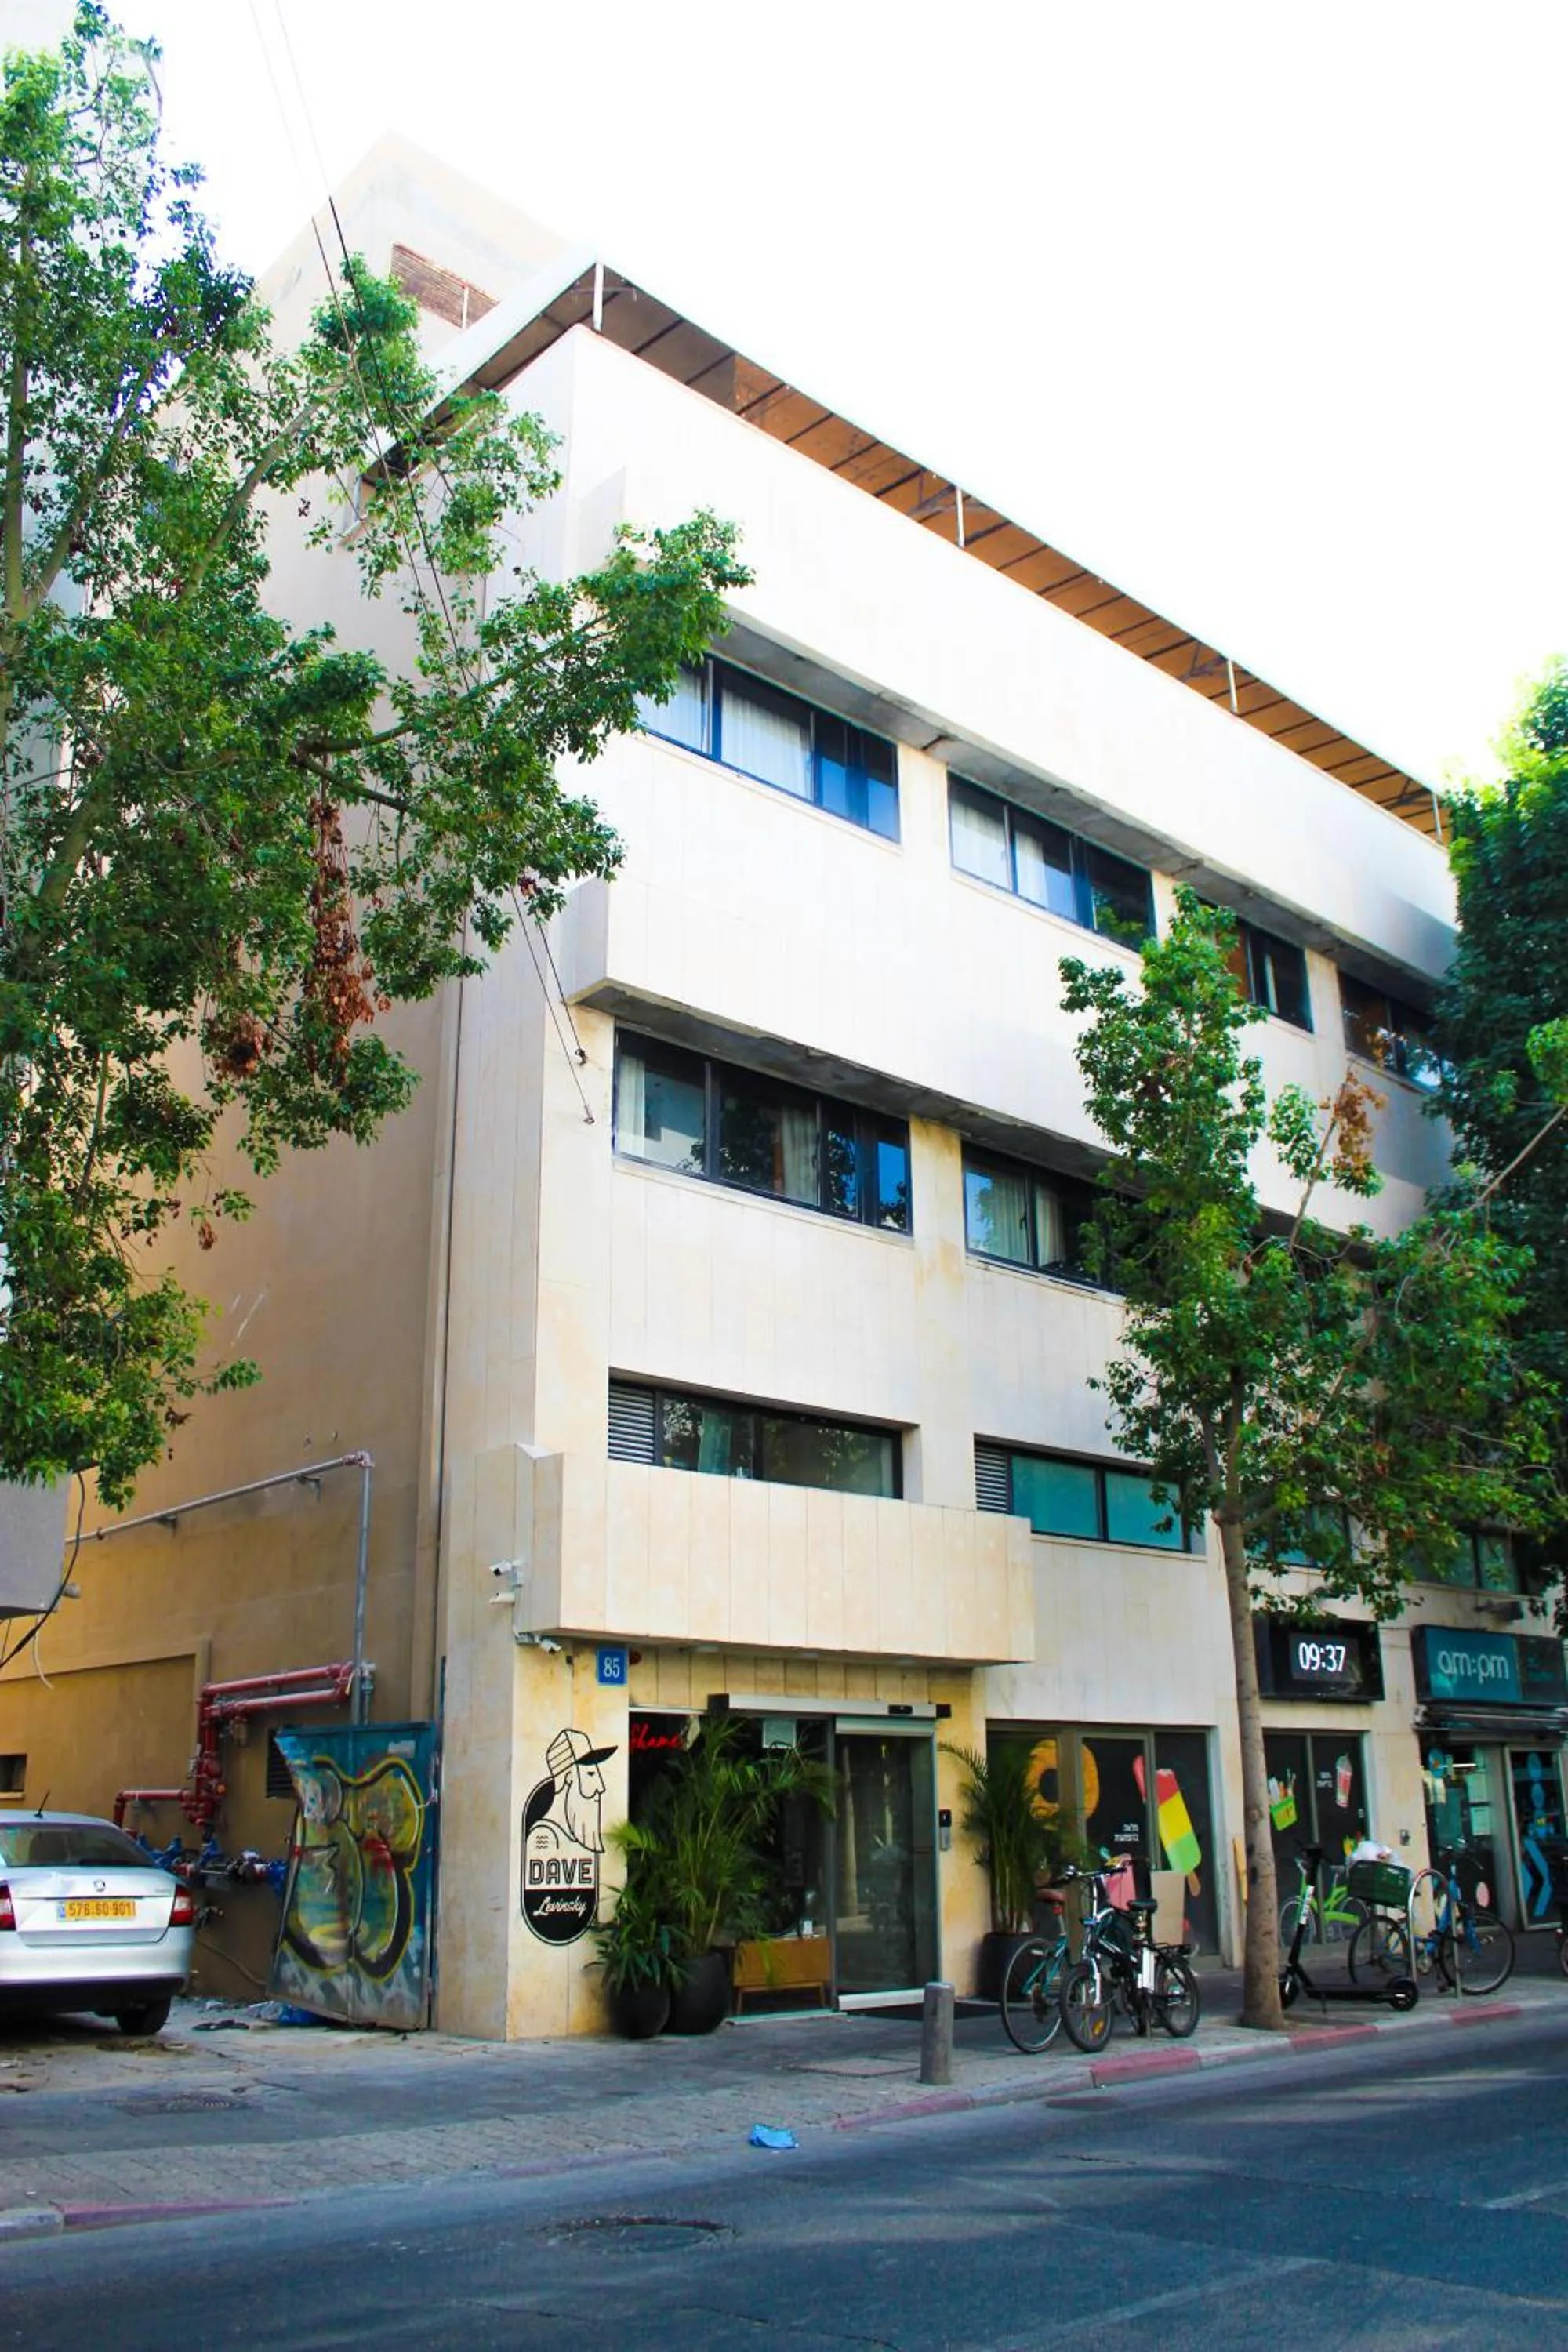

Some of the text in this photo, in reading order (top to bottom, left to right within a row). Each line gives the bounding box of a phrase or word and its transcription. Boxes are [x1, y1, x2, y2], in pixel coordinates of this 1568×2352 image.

[603, 1656, 620, 1677] 85
[1298, 1642, 1346, 1671] 09:37
[1438, 1650, 1509, 1684] am:pm
[529, 1858, 593, 1885] DAVE
[533, 1896, 586, 1918] Levinsky
